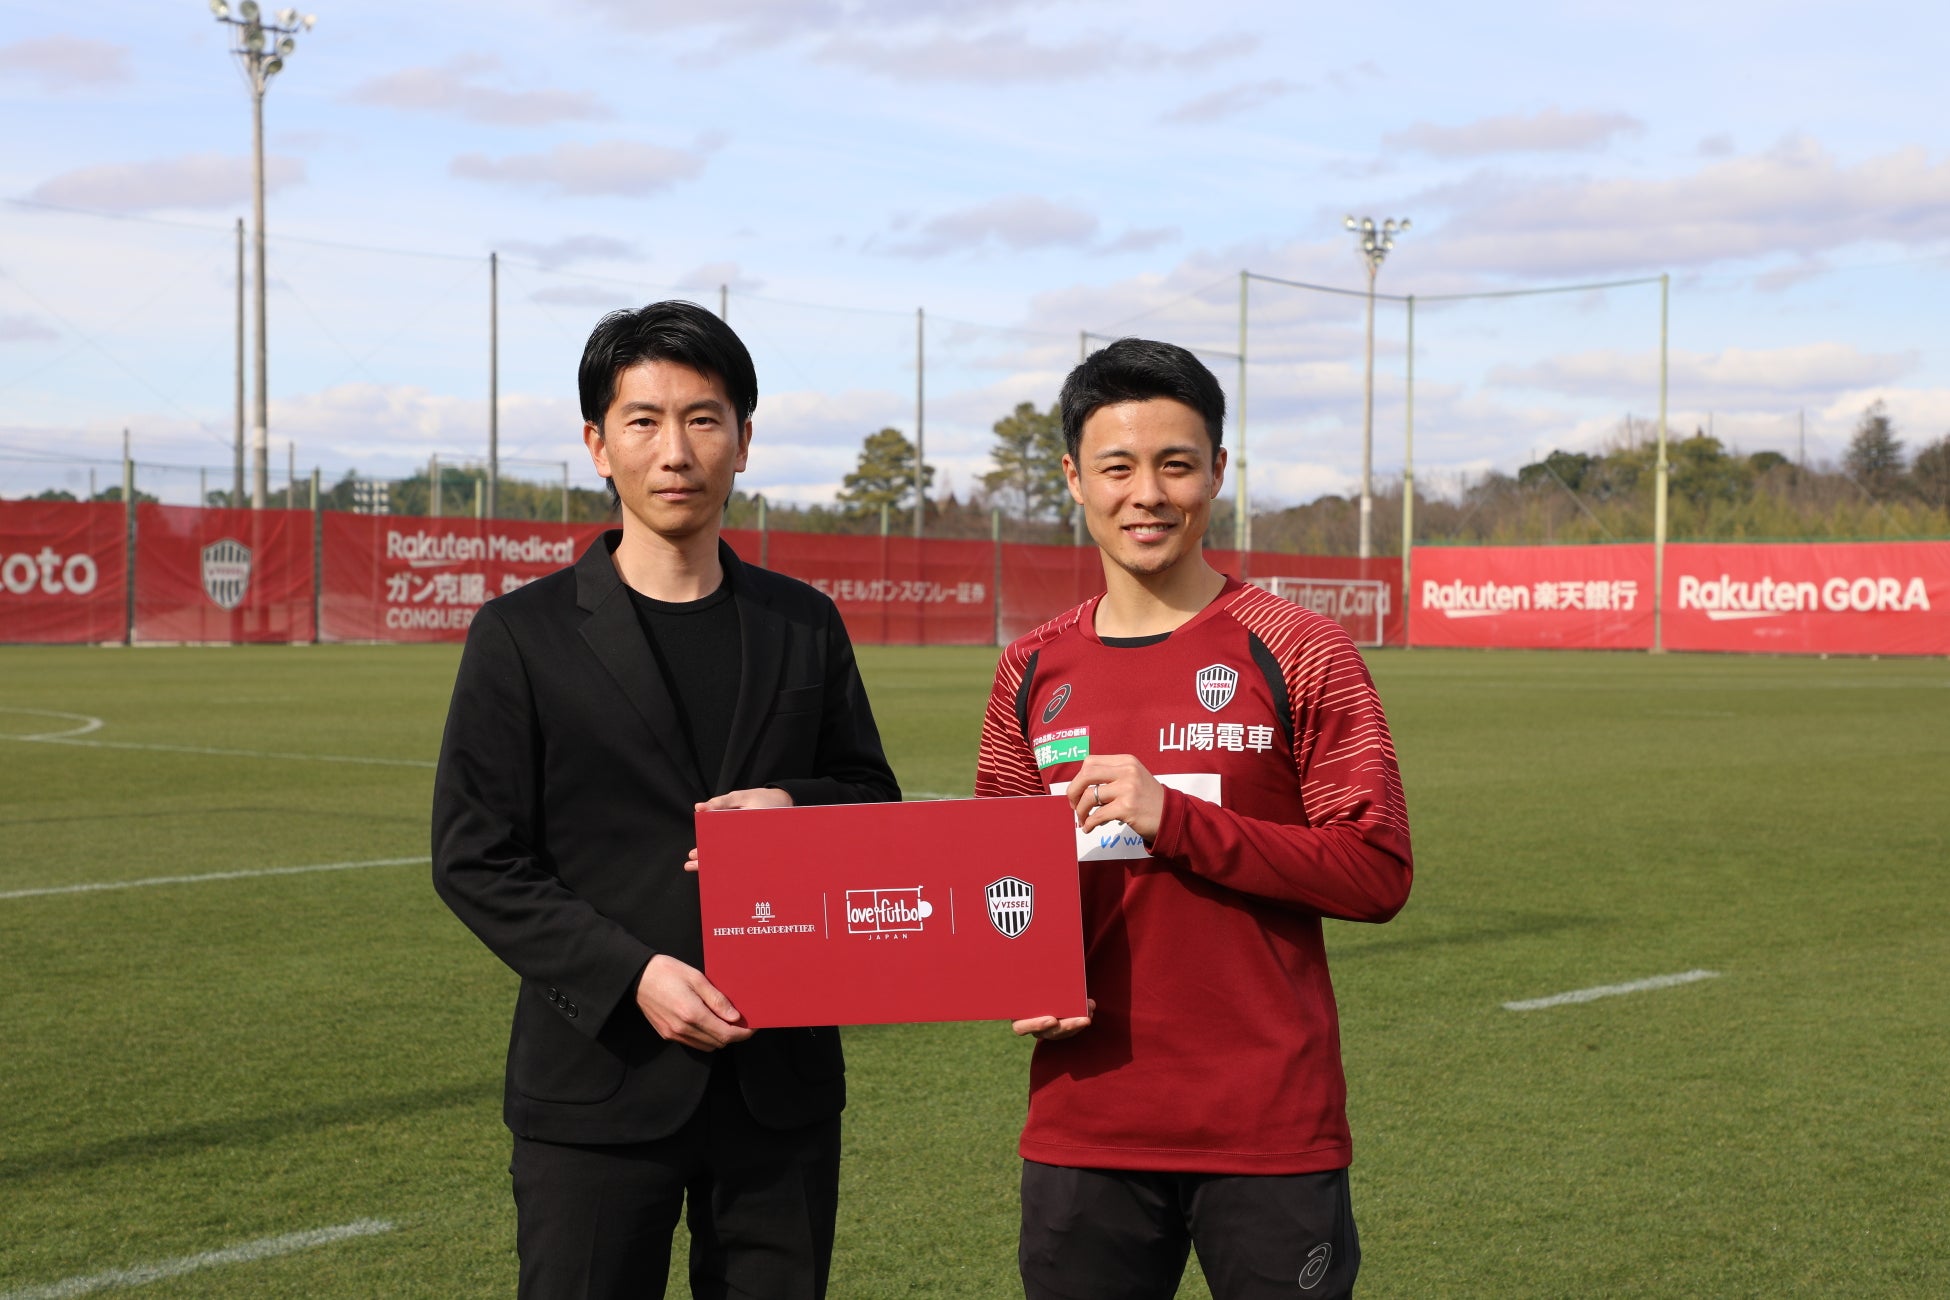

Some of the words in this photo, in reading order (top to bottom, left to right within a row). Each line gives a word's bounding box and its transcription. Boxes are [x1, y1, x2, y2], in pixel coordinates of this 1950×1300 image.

[386, 531, 485, 561] Rakuten
[488, 536, 575, 563] Medical
[0, 546, 97, 595] oto
[1340, 583, 1391, 616] Card
[1422, 579, 1530, 610] Rakuten
[1533, 580, 1638, 610] 楽天銀行
[1678, 574, 1818, 611] Rakuten
[1822, 577, 1931, 611] GORA
[1209, 681, 1231, 689] VISSEL
[1158, 722, 1275, 754] 山陽電車
[1001, 900, 1029, 909] VISSEL
[713, 927, 744, 936] HENRI
[747, 924, 815, 935] CHARPENTIER
[868, 933, 908, 941] JAPAN
